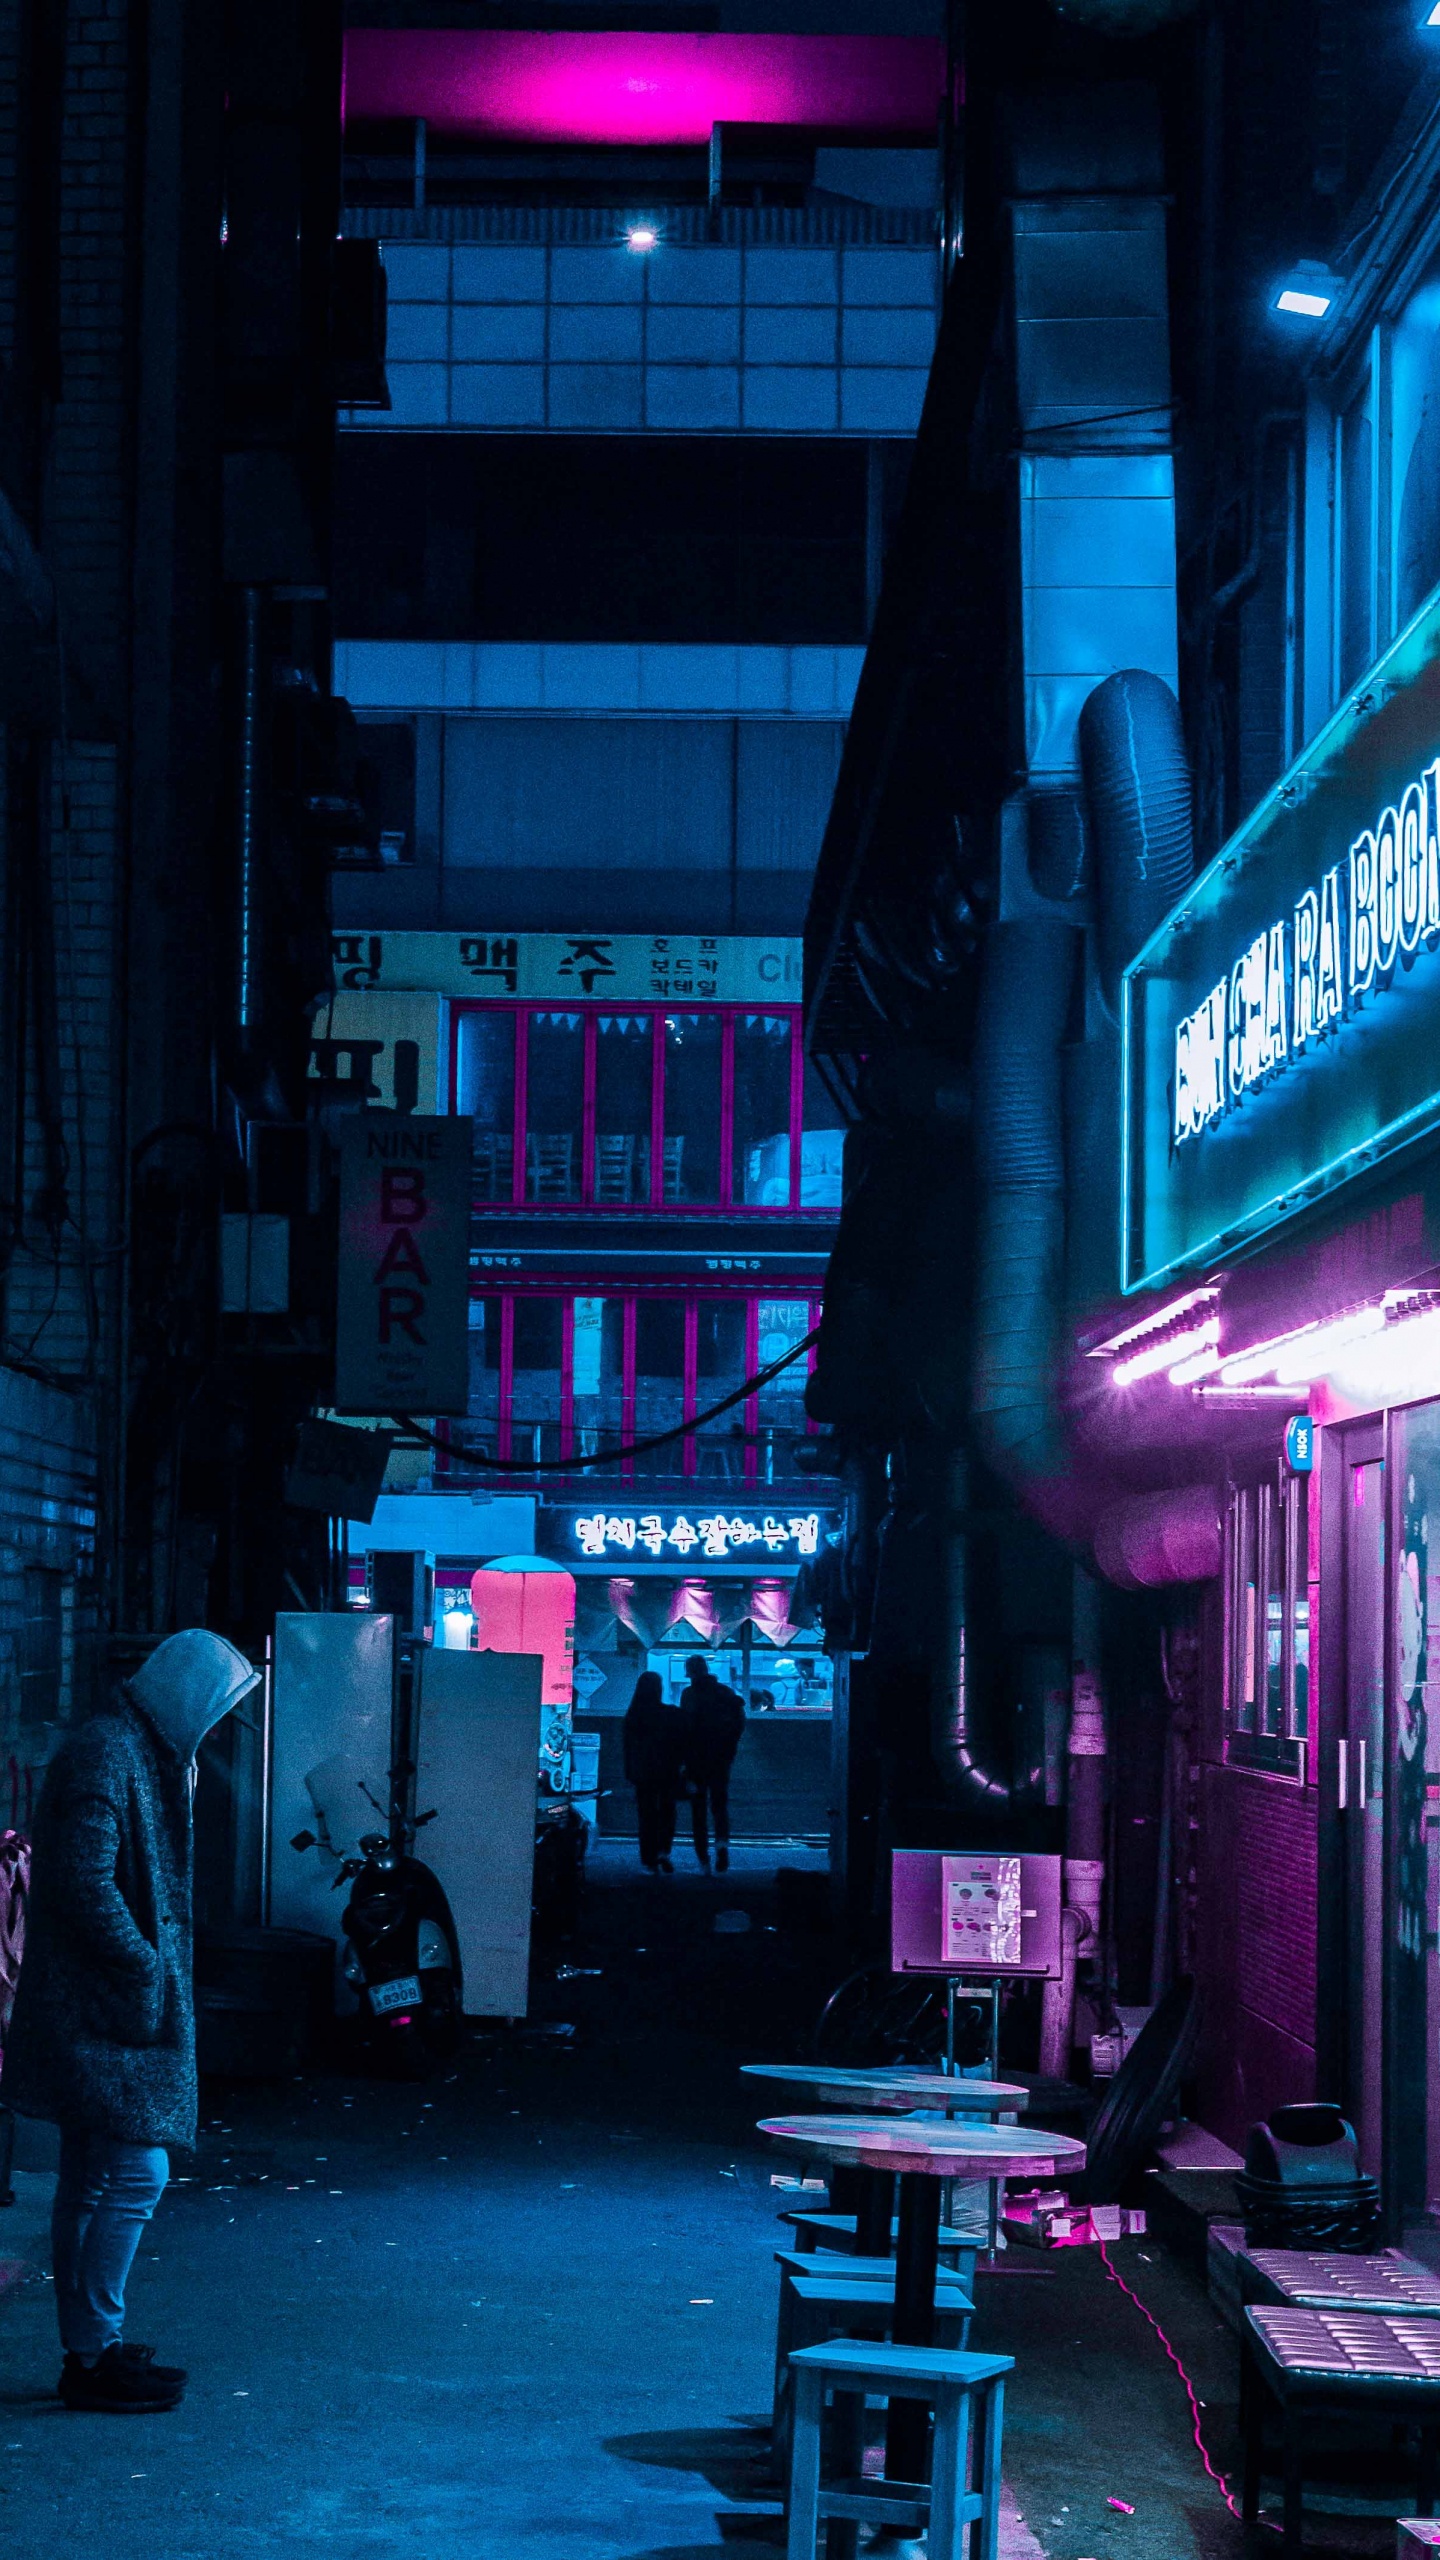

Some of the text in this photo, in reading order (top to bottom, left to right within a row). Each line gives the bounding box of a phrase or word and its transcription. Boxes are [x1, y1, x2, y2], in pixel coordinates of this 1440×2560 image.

[650, 938, 718, 953] 호프
[459, 938, 617, 993] 맥주
[651, 959, 718, 974] 보드카
[650, 979, 718, 998] 칵테일
[1229, 920, 1288, 1096] CHA
[1293, 866, 1343, 1047] RA
[367, 1131, 443, 1160] NINE
[374, 1167, 430, 1346] BAR
